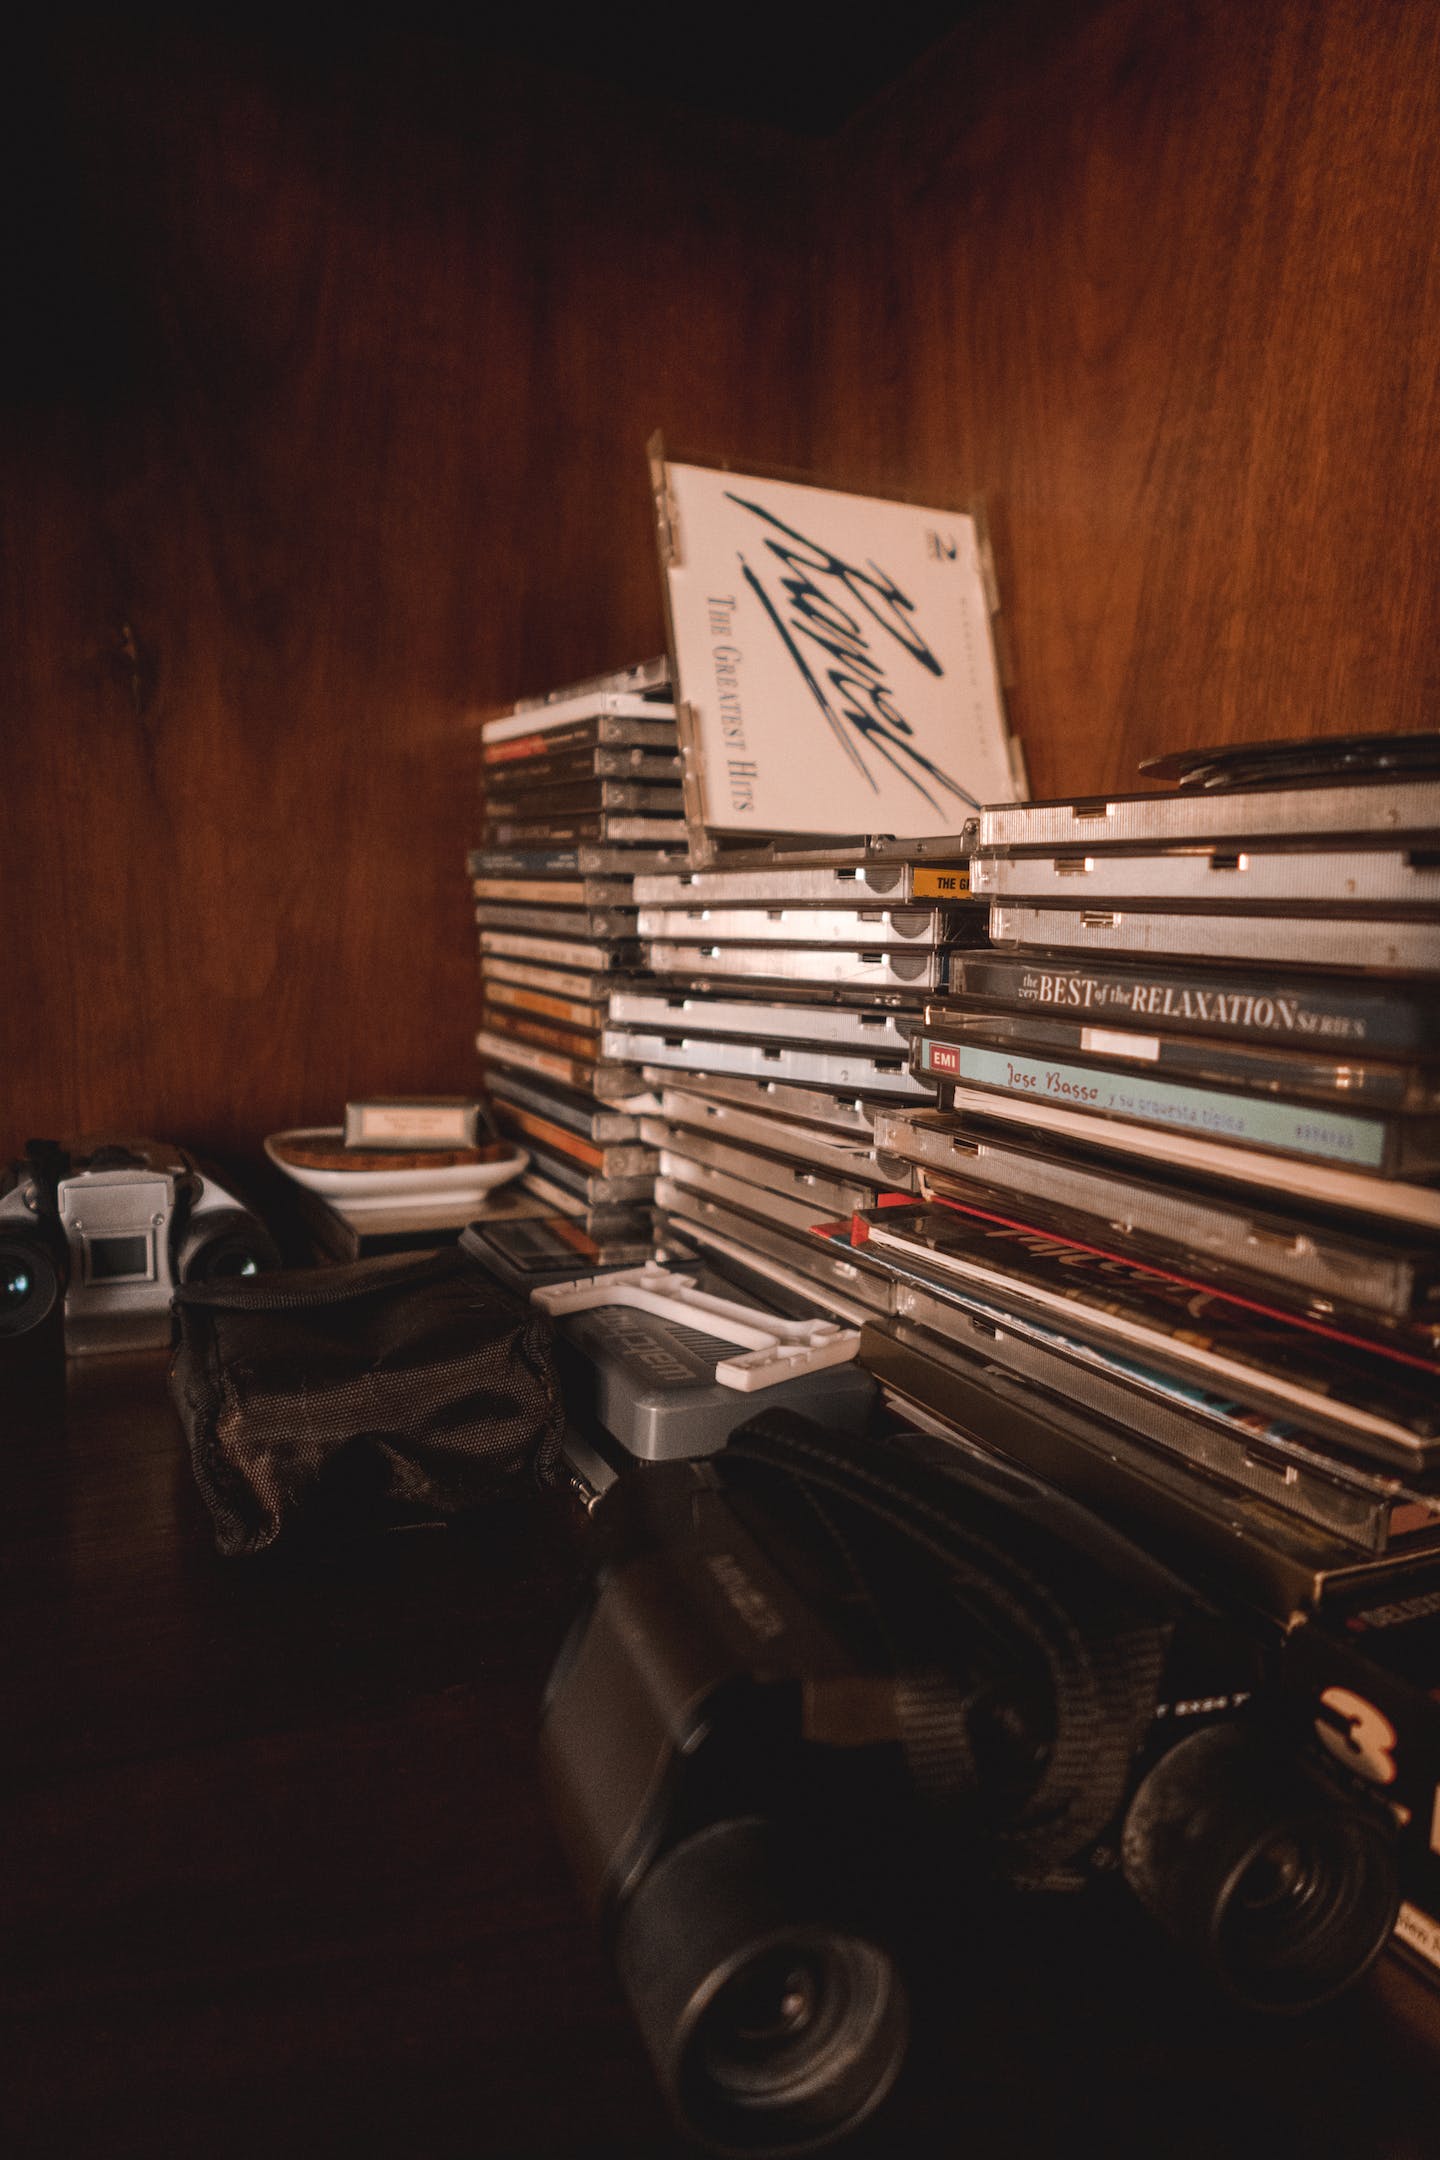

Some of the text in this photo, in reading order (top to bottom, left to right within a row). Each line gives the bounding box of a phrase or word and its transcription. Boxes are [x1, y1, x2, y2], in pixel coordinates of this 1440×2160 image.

[707, 595, 758, 813] THE GREATEST HITS
[937, 877, 957, 890] THE
[1022, 973, 1039, 988] the
[1018, 987, 1039, 1001] very
[1039, 975, 1098, 1008] BEST
[1094, 984, 1110, 1006] of
[1109, 985, 1132, 1005] the
[1130, 985, 1300, 1031] RELAXATION
[933, 1051, 957, 1069] EMI
